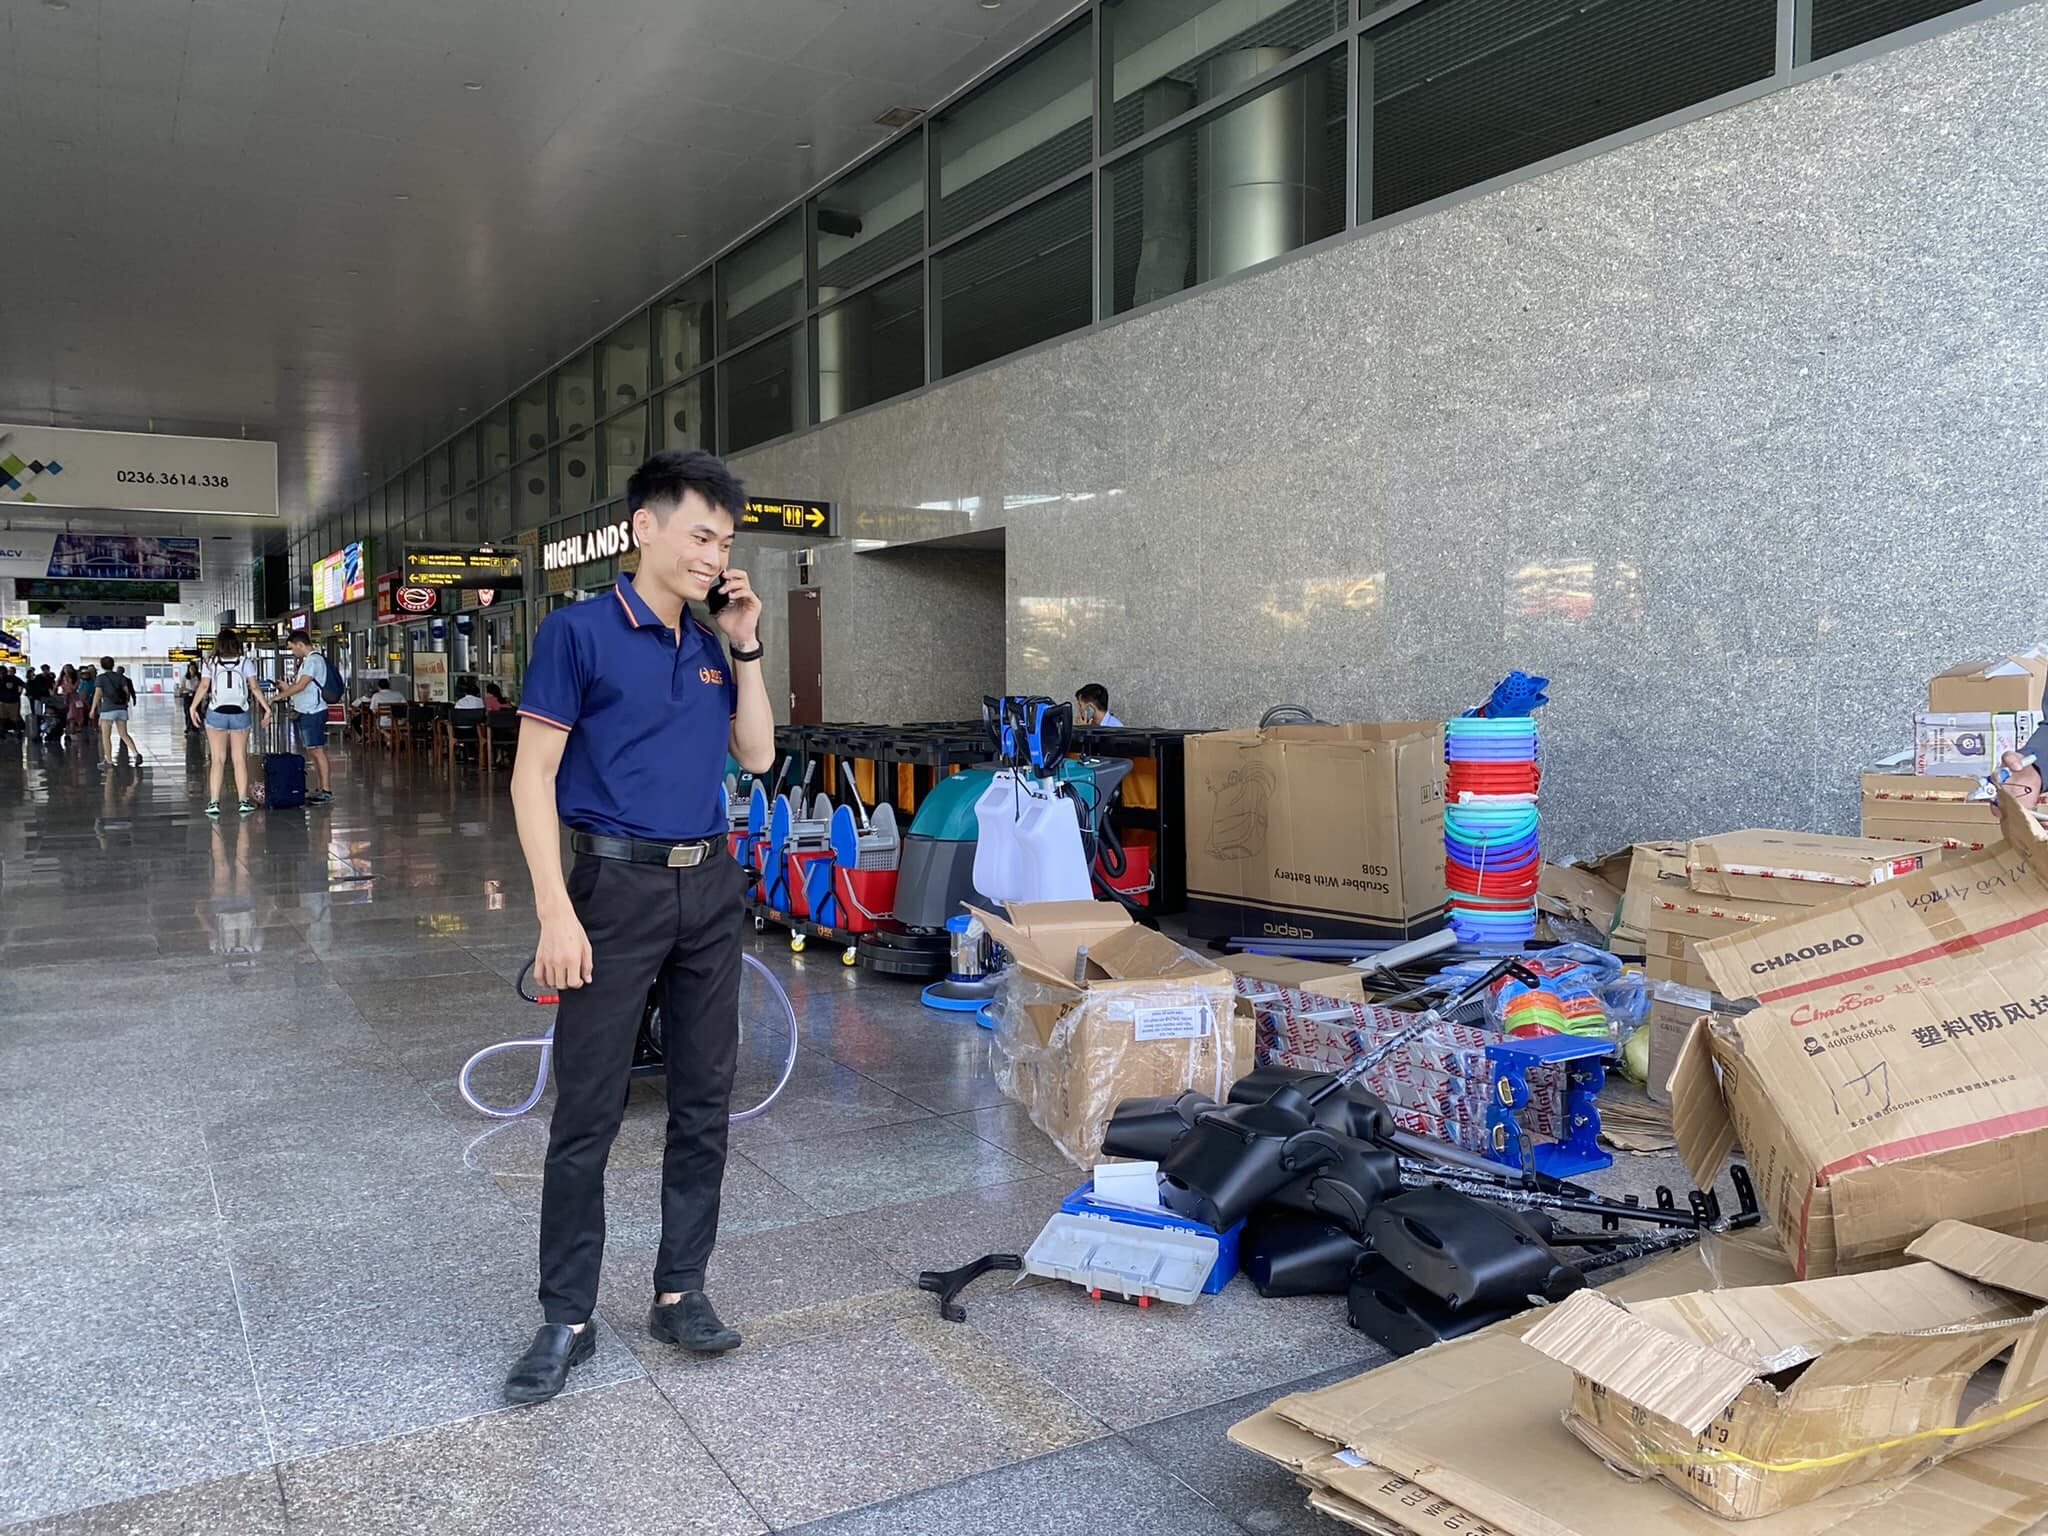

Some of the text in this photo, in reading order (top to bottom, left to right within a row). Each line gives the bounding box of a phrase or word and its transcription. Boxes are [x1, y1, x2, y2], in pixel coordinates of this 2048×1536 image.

[117, 470, 229, 488] 0236.3614.338
[543, 521, 629, 571] HIGHLANDS
[1273, 868, 1390, 895] Scrubber With Battery
[1361, 864, 1389, 877] C50B
[1750, 933, 1865, 974] CHAOBAO
[1827, 1024, 1897, 1050] 4008868648
[1443, 1512, 1473, 1530] QTY
